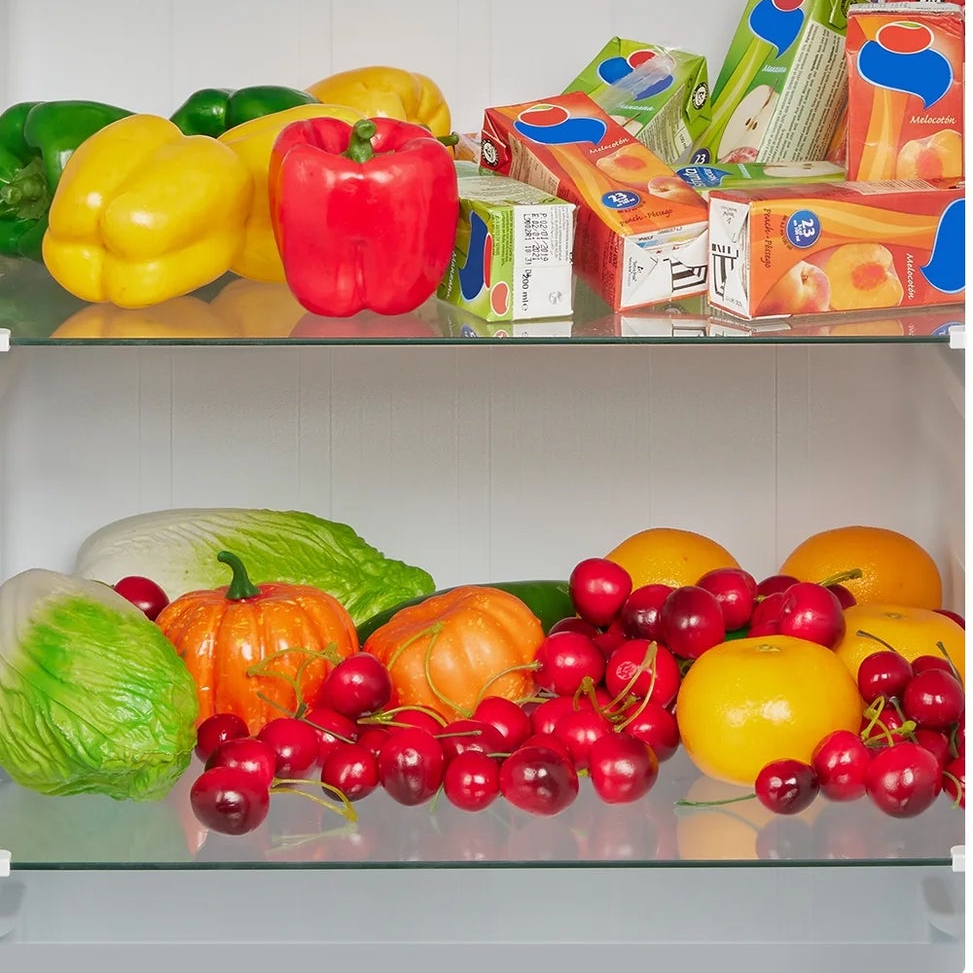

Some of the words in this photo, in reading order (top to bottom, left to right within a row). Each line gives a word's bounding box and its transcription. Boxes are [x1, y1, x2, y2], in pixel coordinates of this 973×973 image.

[909, 113, 957, 125] Melocotón
[589, 137, 630, 156] Melocotón
[607, 192, 628, 204] 23
[763, 208, 774, 234] Peach
[801, 218, 815, 238] 23
[905, 252, 916, 301] Melocotón
